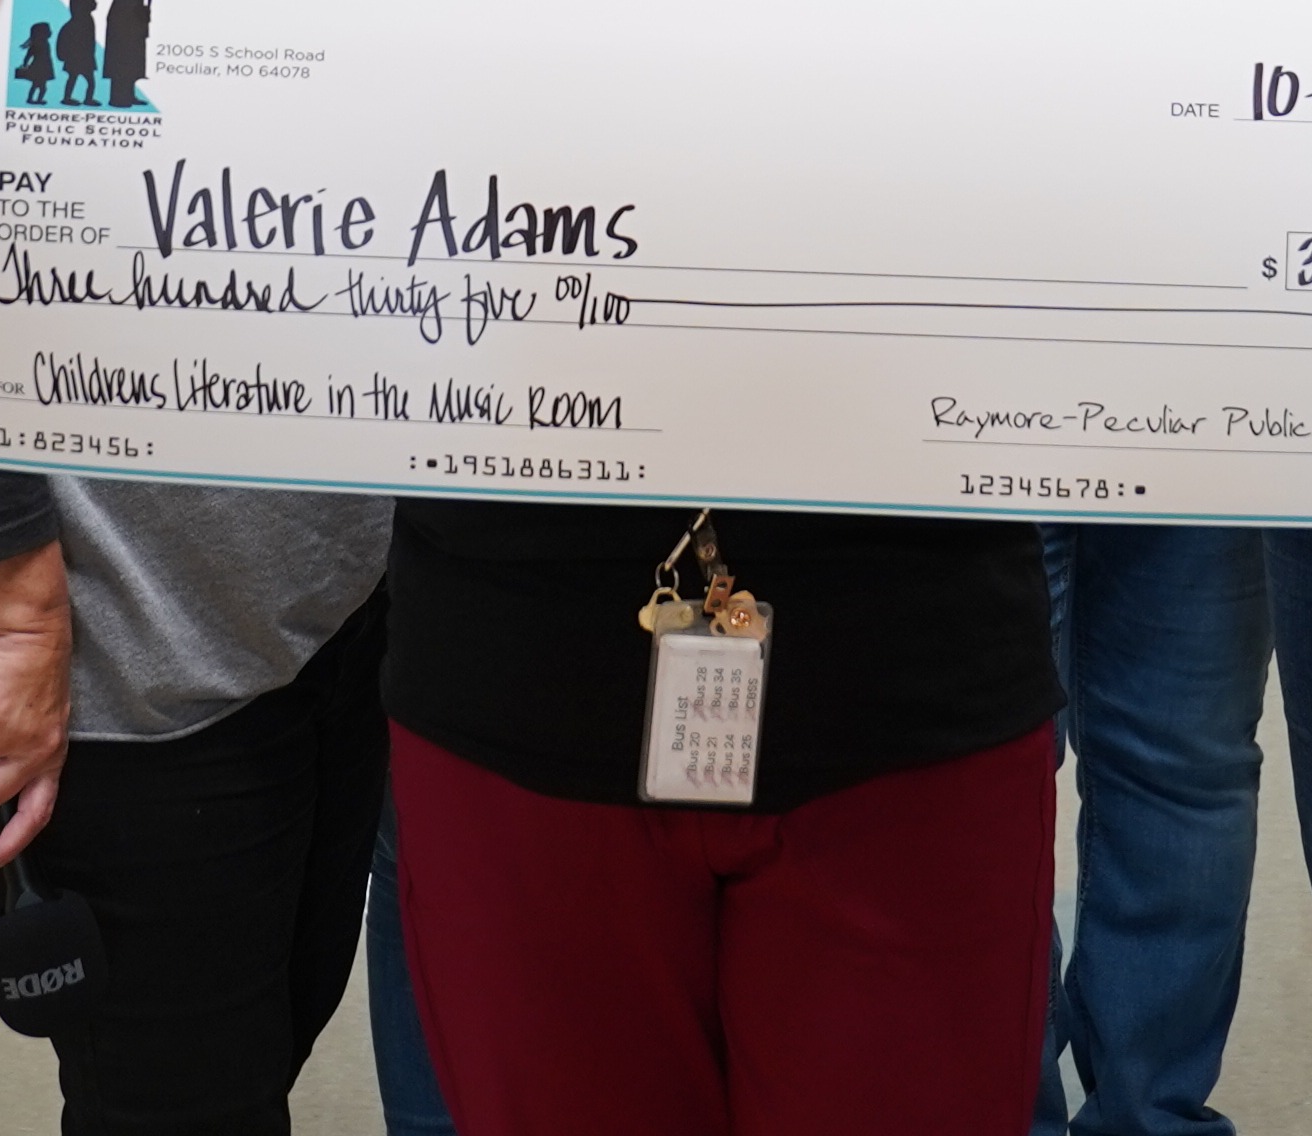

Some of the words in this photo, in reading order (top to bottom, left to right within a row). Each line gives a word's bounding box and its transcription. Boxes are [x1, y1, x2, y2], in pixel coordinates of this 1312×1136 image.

[156, 43, 204, 58] 21005
[209, 45, 220, 58] S
[224, 46, 279, 61] School
[284, 48, 326, 62] Road
[155, 61, 222, 77] Peculiar,
[226, 64, 253, 77] MO
[259, 65, 311, 79] 64078
[1170, 102, 1220, 119] DATE
[37, 200, 86, 219] THE
[142, 158, 377, 259] Valerie
[407, 168, 639, 267] Adams
[81, 227, 111, 245] OF
[1262, 256, 1278, 281] $
[108, 250, 328, 313] hundred
[334, 267, 451, 344] thirty
[33, 350, 167, 410] Childrens
[173, 357, 313, 416] Literature
[328, 373, 355, 419] in
[362, 372, 410, 421] the
[930, 396, 1208, 439] Raymore-Peculiar
[1221, 405, 1312, 439] Public
[674, 695, 688, 720] List
[672, 723, 686, 752] Bus
